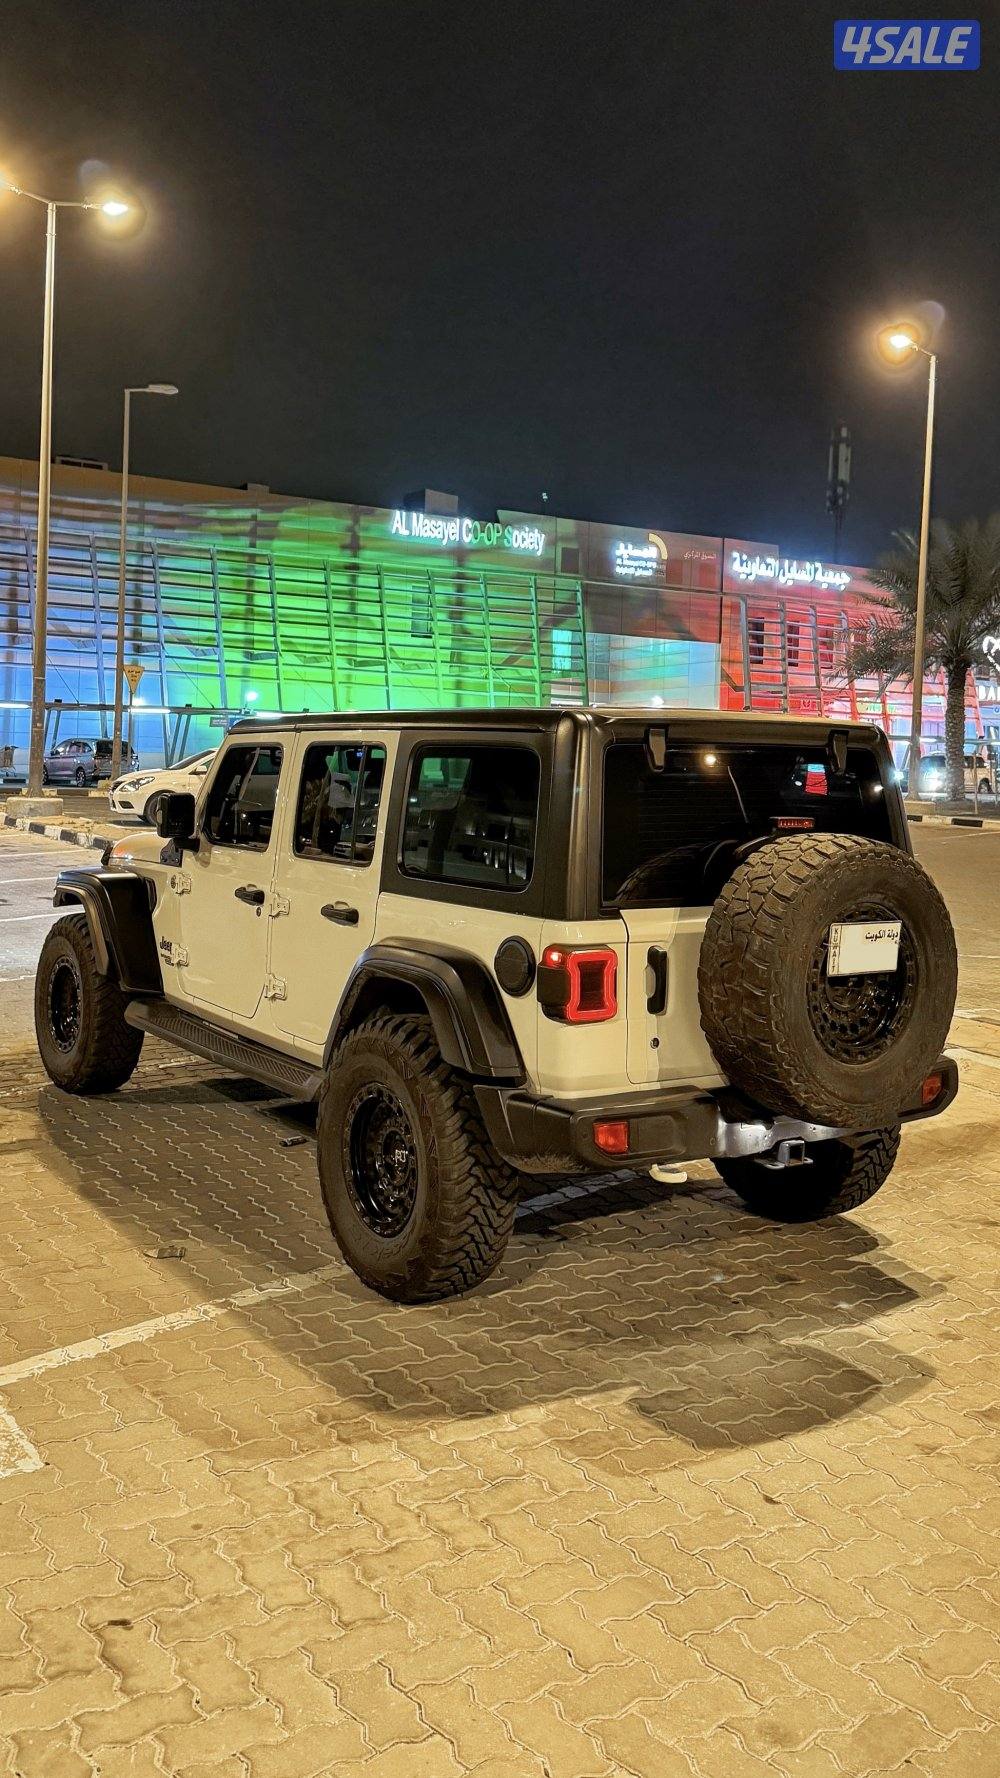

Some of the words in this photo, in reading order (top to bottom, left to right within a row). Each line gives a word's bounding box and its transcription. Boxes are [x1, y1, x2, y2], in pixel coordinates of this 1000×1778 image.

[391, 510, 410, 536] AL
[411, 512, 460, 546] Masayel
[462, 517, 502, 546] CO-OP
[504, 524, 546, 556] Society
[732, 551, 779, 581] التعاونية
[779, 559, 815, 586] المسايل
[814, 561, 851, 591] جمعية
[865, 929, 886, 942] الكويت
